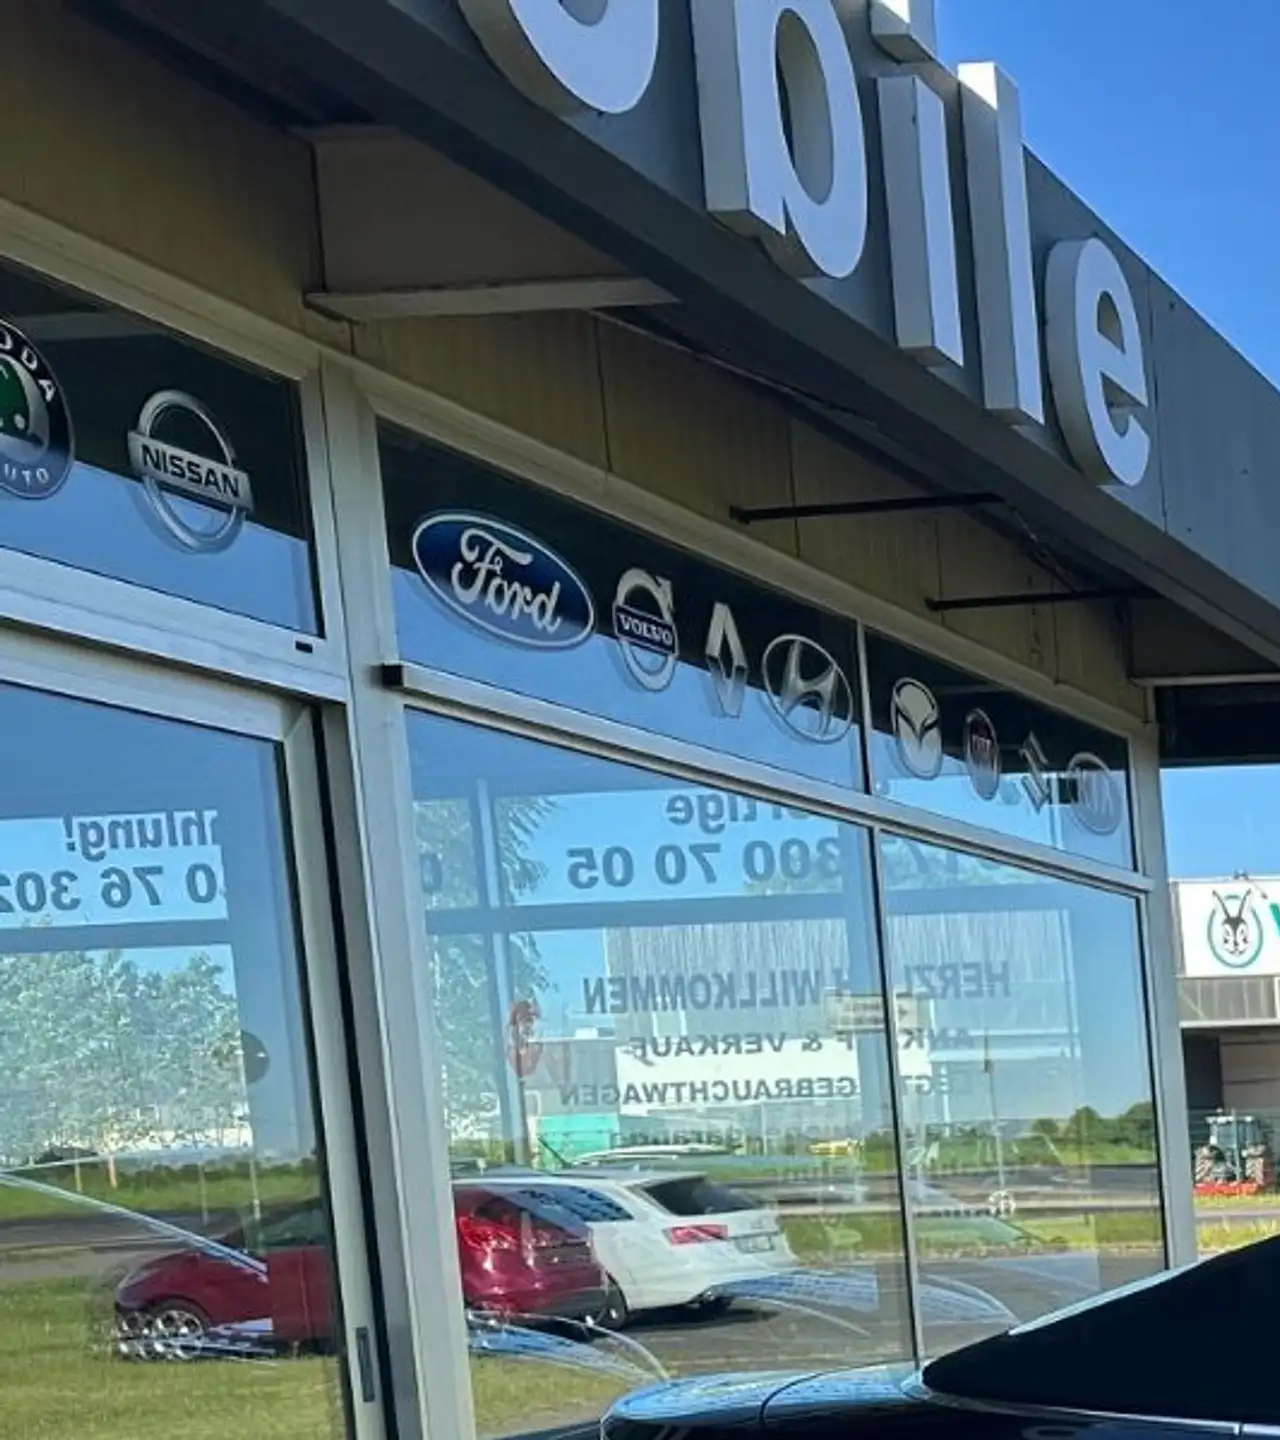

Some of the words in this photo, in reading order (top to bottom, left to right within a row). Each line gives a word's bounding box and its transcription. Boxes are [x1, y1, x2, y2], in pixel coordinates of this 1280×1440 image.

[455, 0, 1151, 487] bile
[140, 443, 240, 499] NISSAN
[451, 527, 561, 633] Ford
[617, 612, 673, 645] VOLVO
